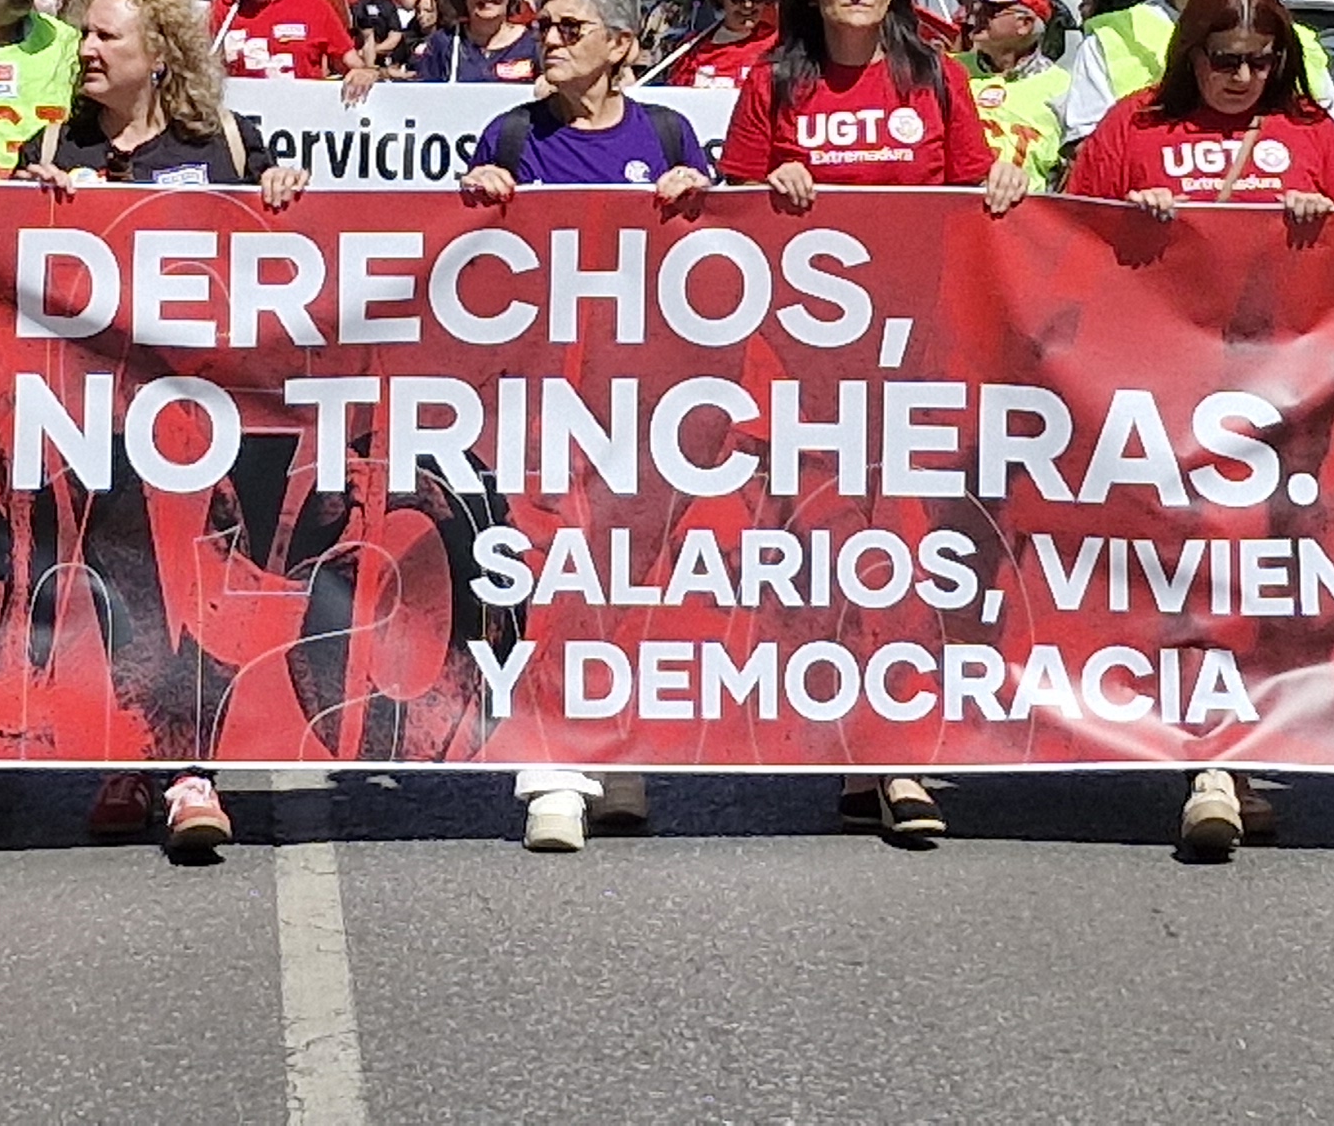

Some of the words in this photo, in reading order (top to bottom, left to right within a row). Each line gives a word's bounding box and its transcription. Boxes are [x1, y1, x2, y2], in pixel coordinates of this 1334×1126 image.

[251, 115, 478, 182] ervicios
[796, 109, 884, 148] UGT
[810, 146, 914, 165] Extremadura
[1162, 140, 1244, 177] UGT
[1182, 174, 1283, 192] Extreadura
[17, 228, 913, 368] DERECHOS,
[12, 374, 243, 494] NO
[285, 376, 1319, 511] TRINCHERAS.
[471, 528, 1005, 624] SALARIOS,
[467, 641, 529, 718] Y
[565, 640, 1258, 725] DEMOCRACIA
